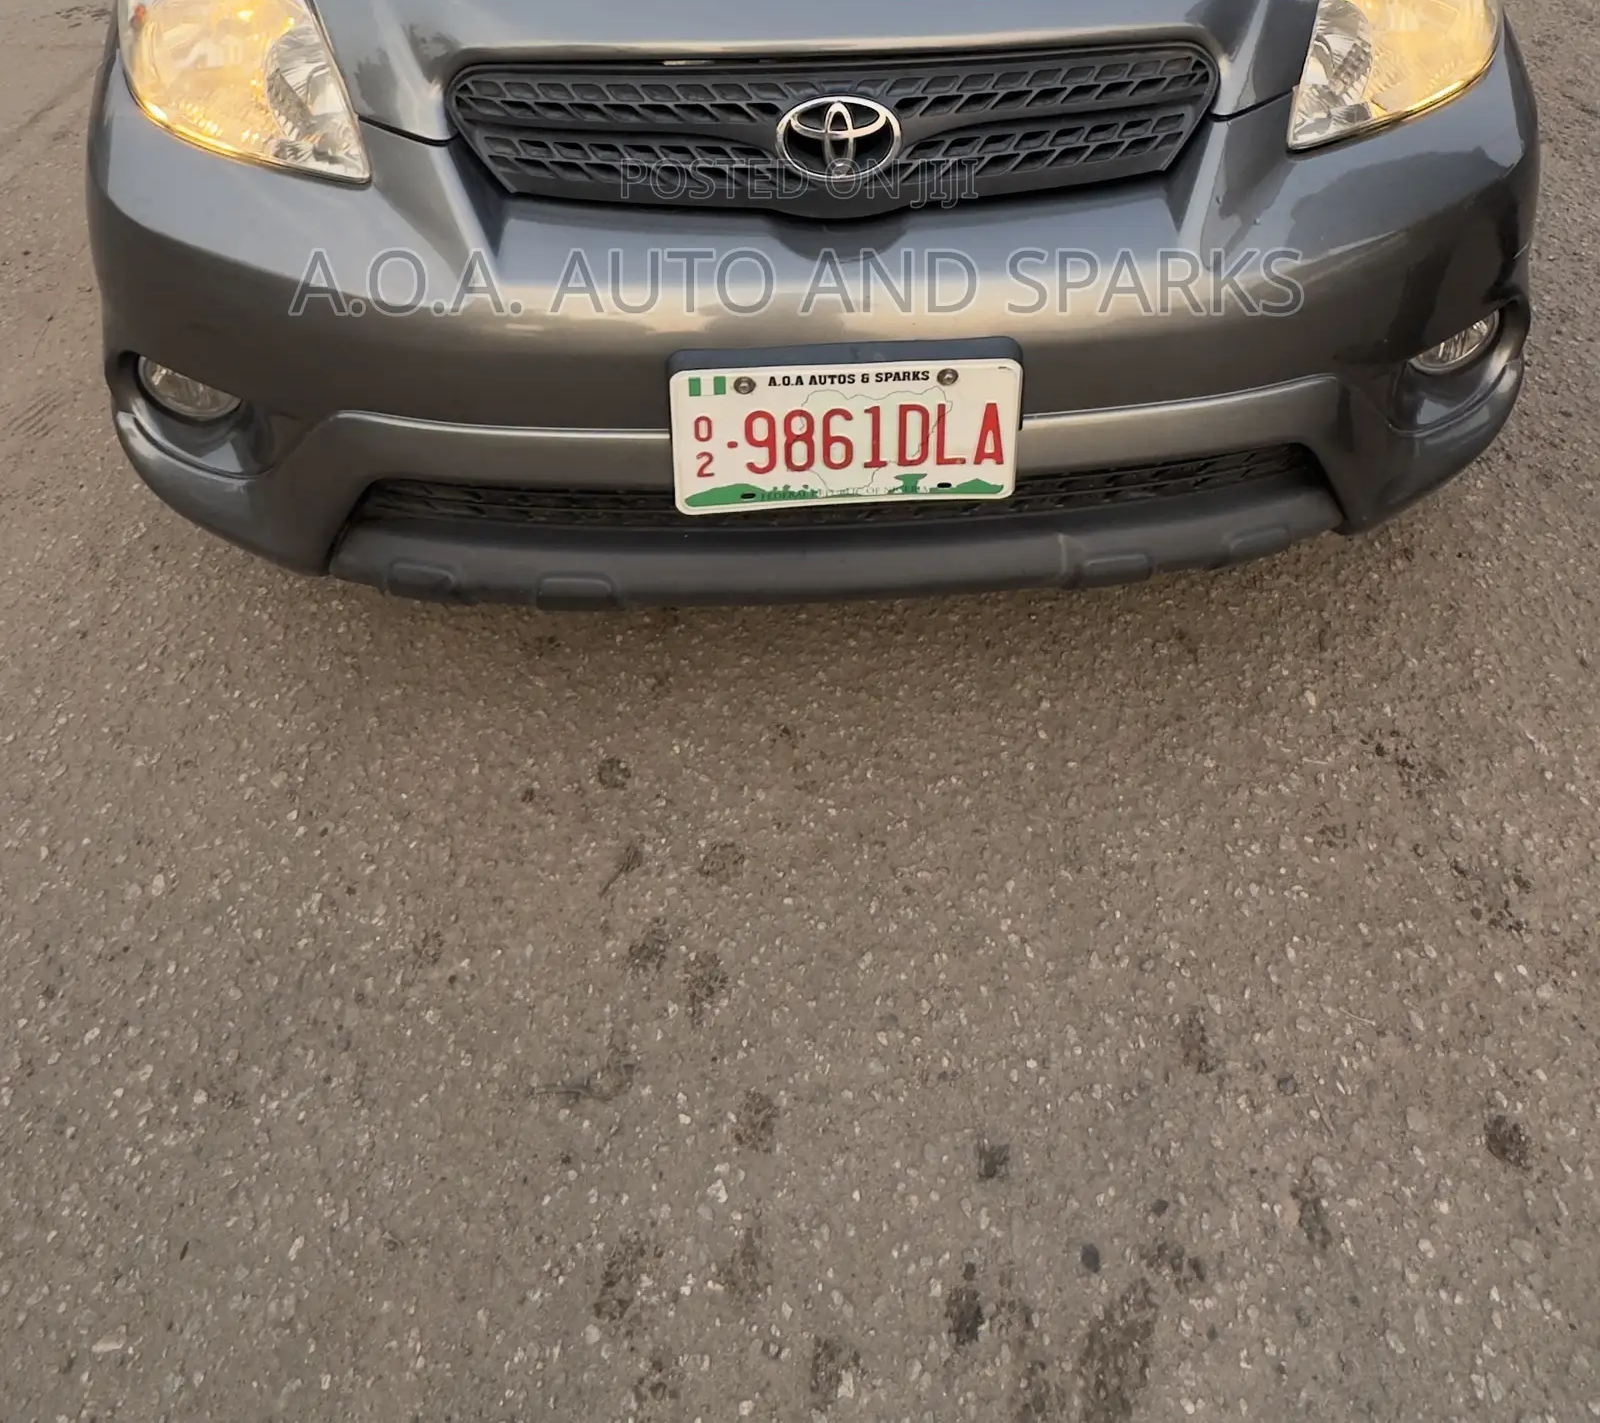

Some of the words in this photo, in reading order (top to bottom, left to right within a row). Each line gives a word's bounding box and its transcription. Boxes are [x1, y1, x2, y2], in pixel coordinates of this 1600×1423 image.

[768, 375, 804, 387] A.O.A
[808, 373, 856, 386] AUTOS
[861, 372, 870, 384] &
[875, 370, 930, 383] SPARKS
